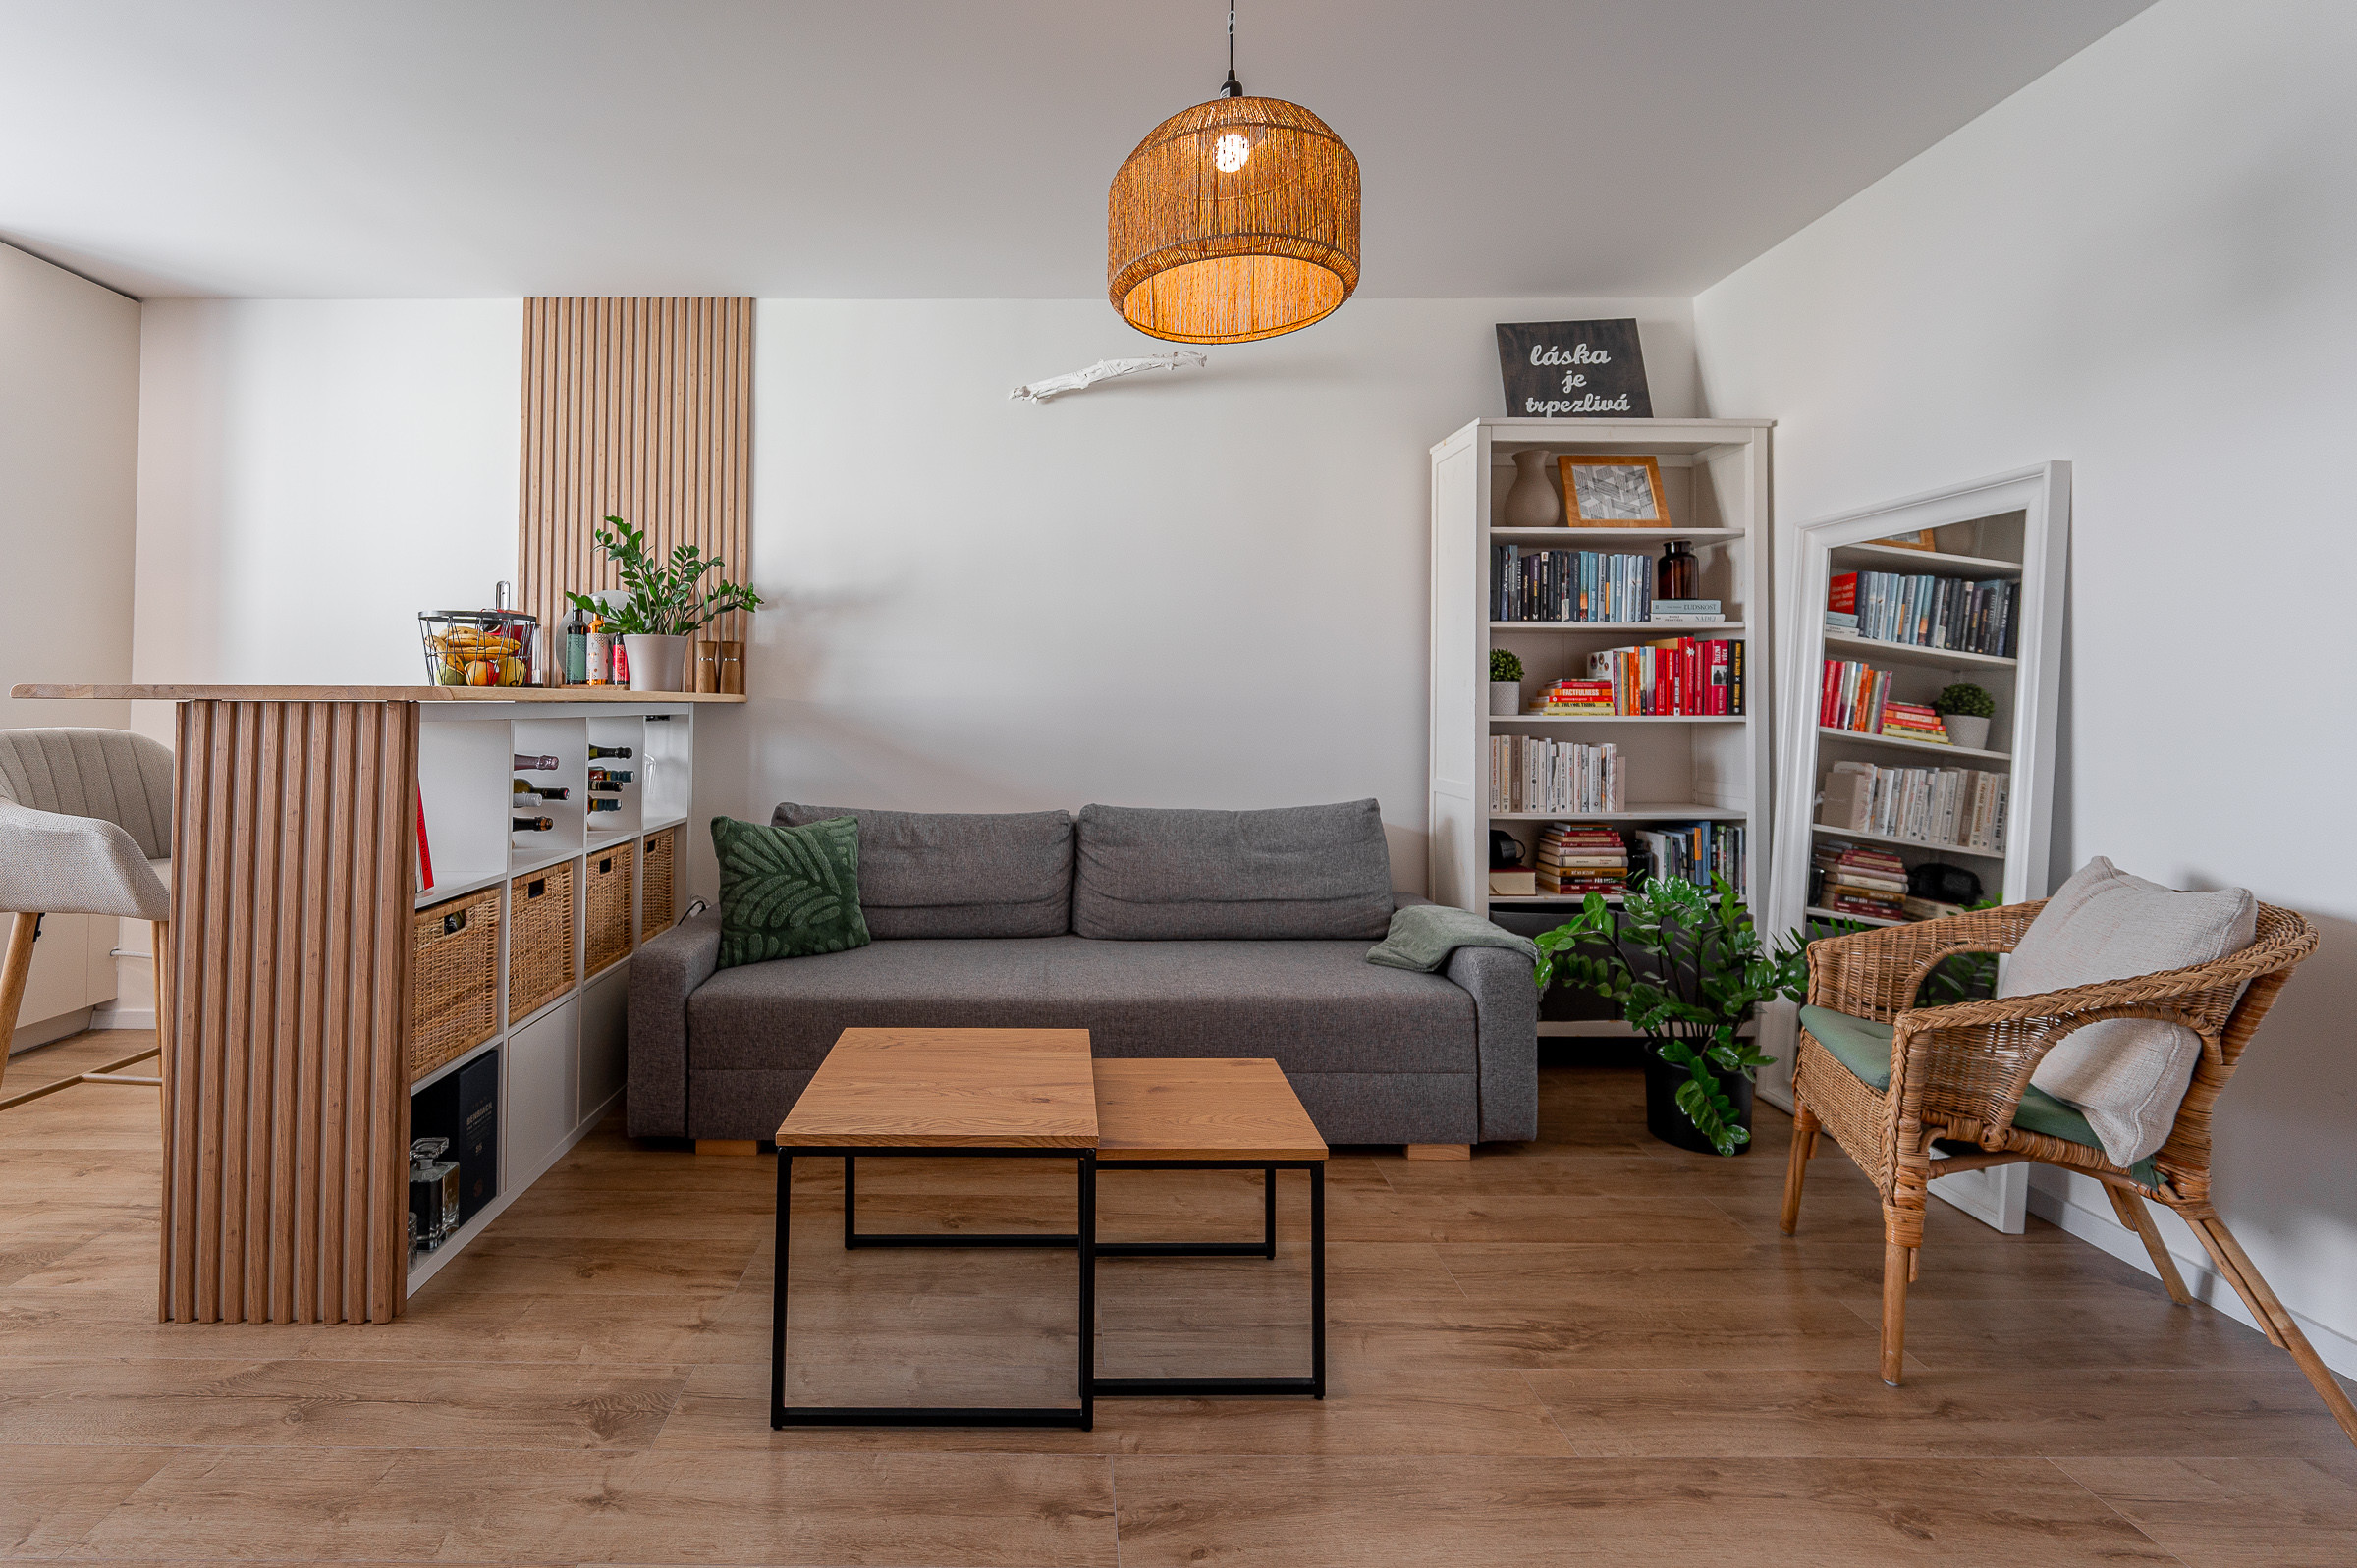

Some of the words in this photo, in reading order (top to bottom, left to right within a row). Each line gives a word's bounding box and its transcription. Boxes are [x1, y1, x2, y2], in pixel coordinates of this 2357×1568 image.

[1530, 343, 1612, 366] láska
[1562, 370, 1587, 393] je
[1525, 393, 1631, 418] trpezlivá
